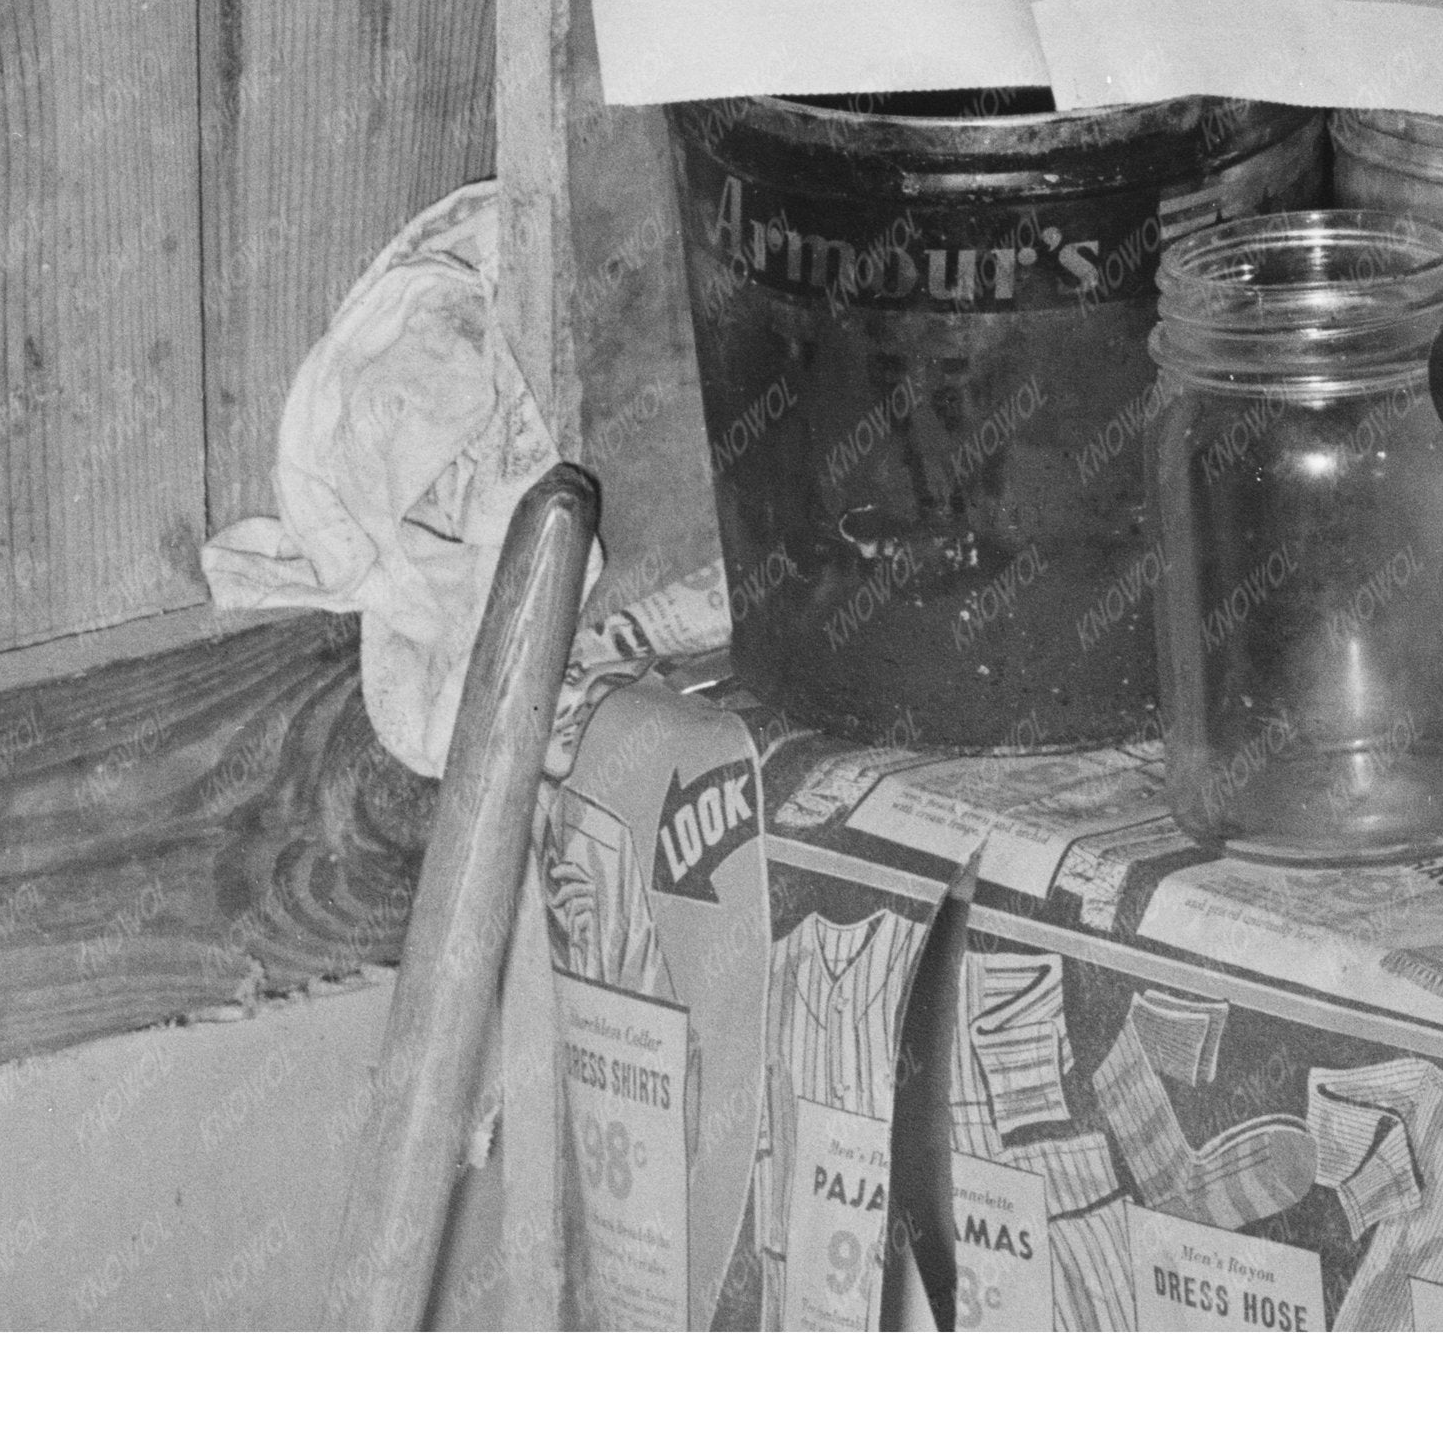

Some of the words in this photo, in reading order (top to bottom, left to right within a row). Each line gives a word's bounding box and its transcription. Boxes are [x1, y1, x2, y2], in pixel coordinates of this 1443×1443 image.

[710, 174, 1102, 302] Armour's
[660, 774, 753, 883] LOOK
[611, 1059, 672, 1110] SHIRTS
[1181, 1245, 1224, 1270] Men's
[1228, 1256, 1276, 1284] Rayon
[1153, 1265, 1230, 1319] DRESS
[1243, 1291, 1308, 1332] HOSE
